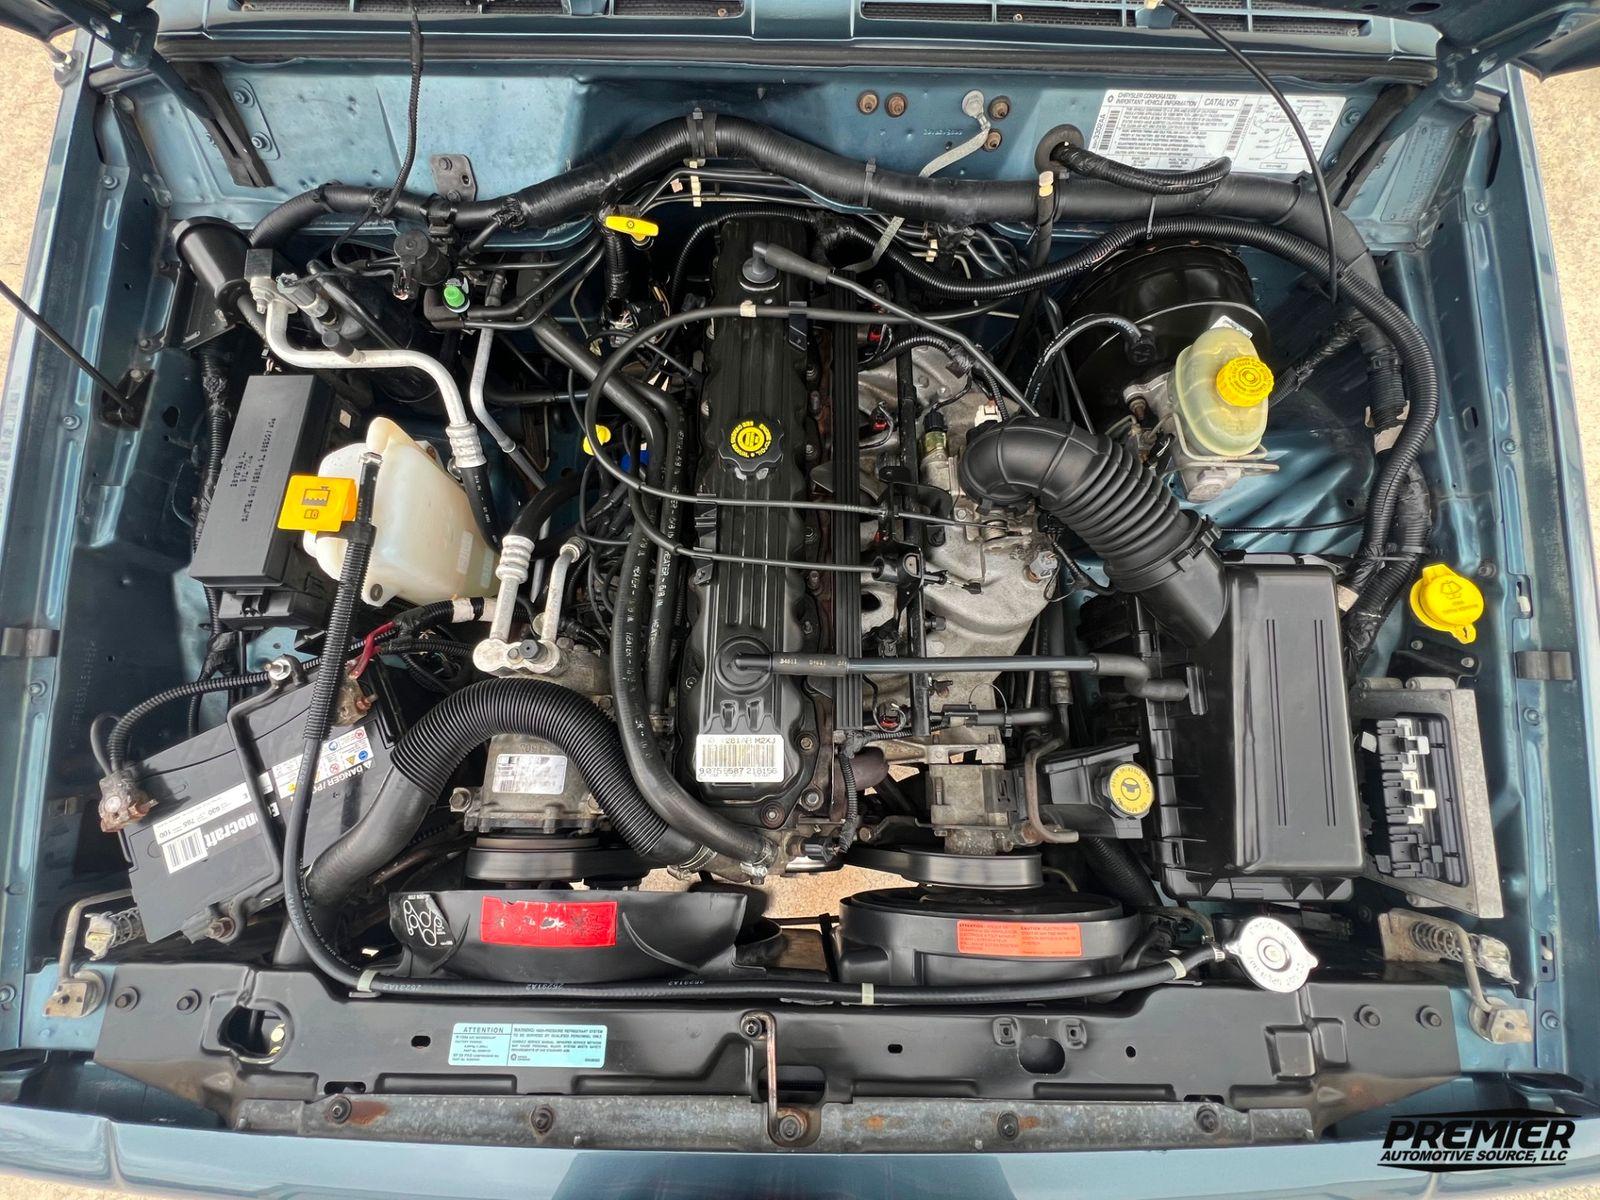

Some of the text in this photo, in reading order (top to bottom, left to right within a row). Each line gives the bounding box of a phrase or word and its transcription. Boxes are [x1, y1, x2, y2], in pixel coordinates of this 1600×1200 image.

[1204, 98, 1239, 107] CATALYST
[661, 551, 672, 577] HEATER
[327, 765, 363, 786] DANGER
